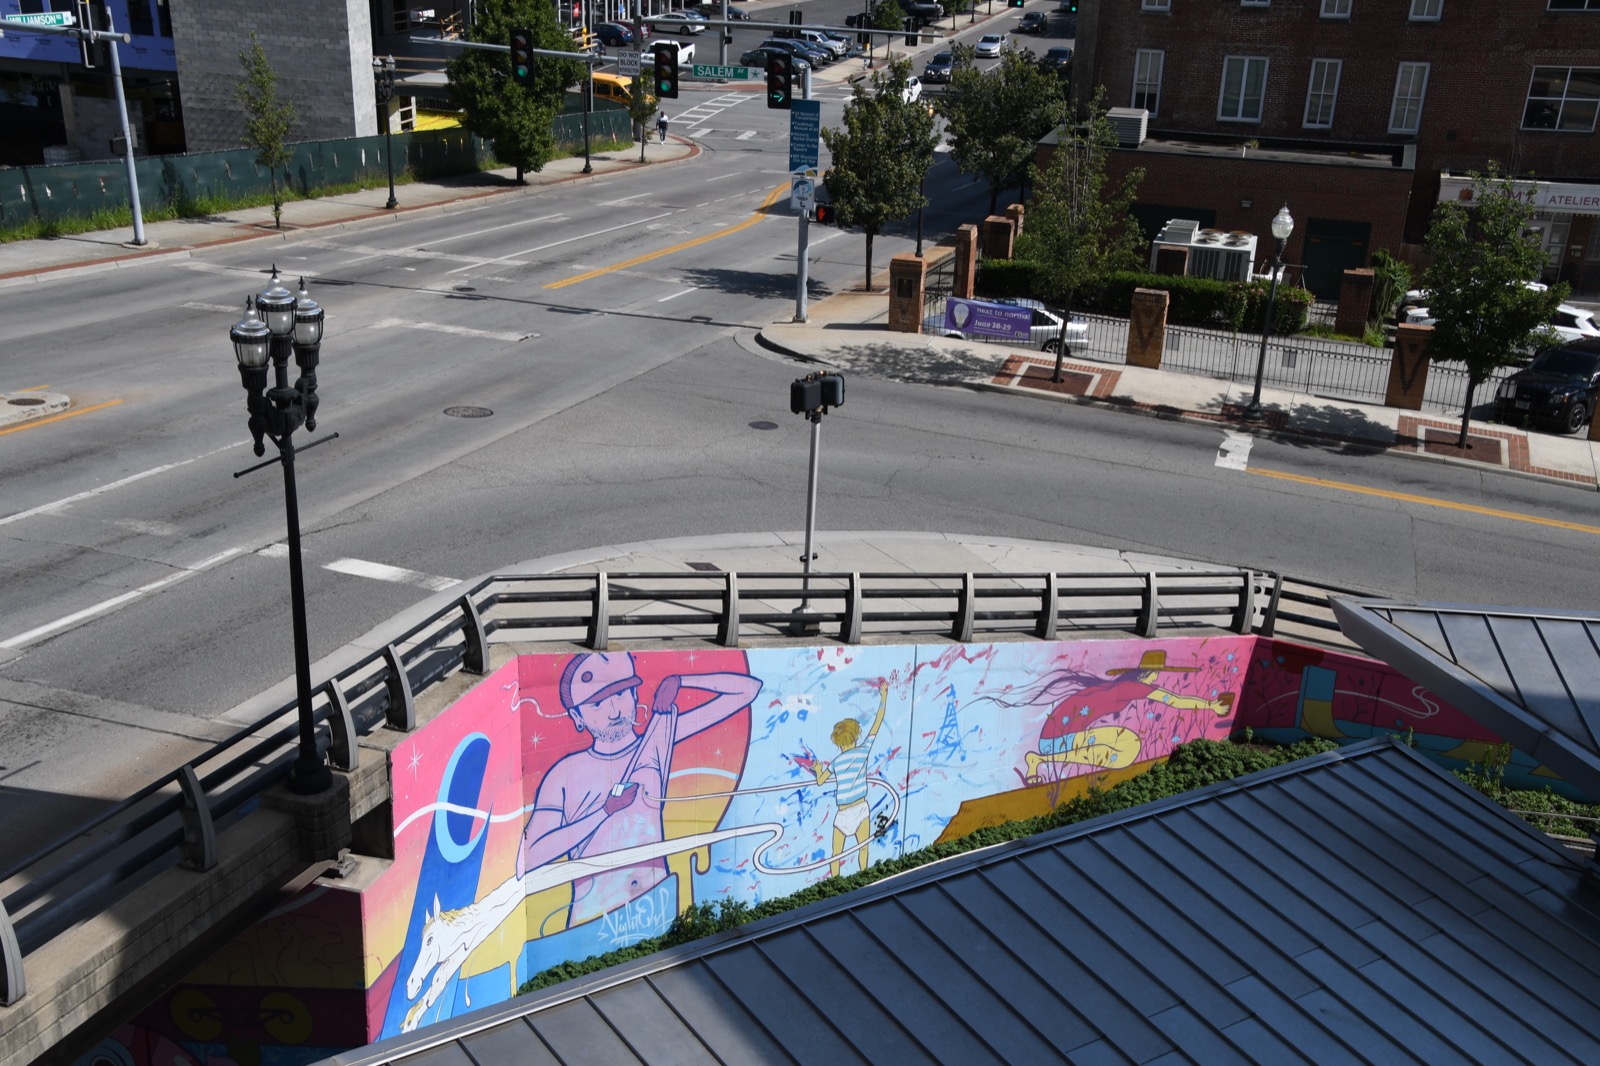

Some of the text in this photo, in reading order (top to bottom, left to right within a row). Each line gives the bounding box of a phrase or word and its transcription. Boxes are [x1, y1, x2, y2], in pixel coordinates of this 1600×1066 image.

[698, 66, 734, 78] SALEM
[1548, 195, 1600, 206] ATELIER
[975, 319, 991, 327] June
